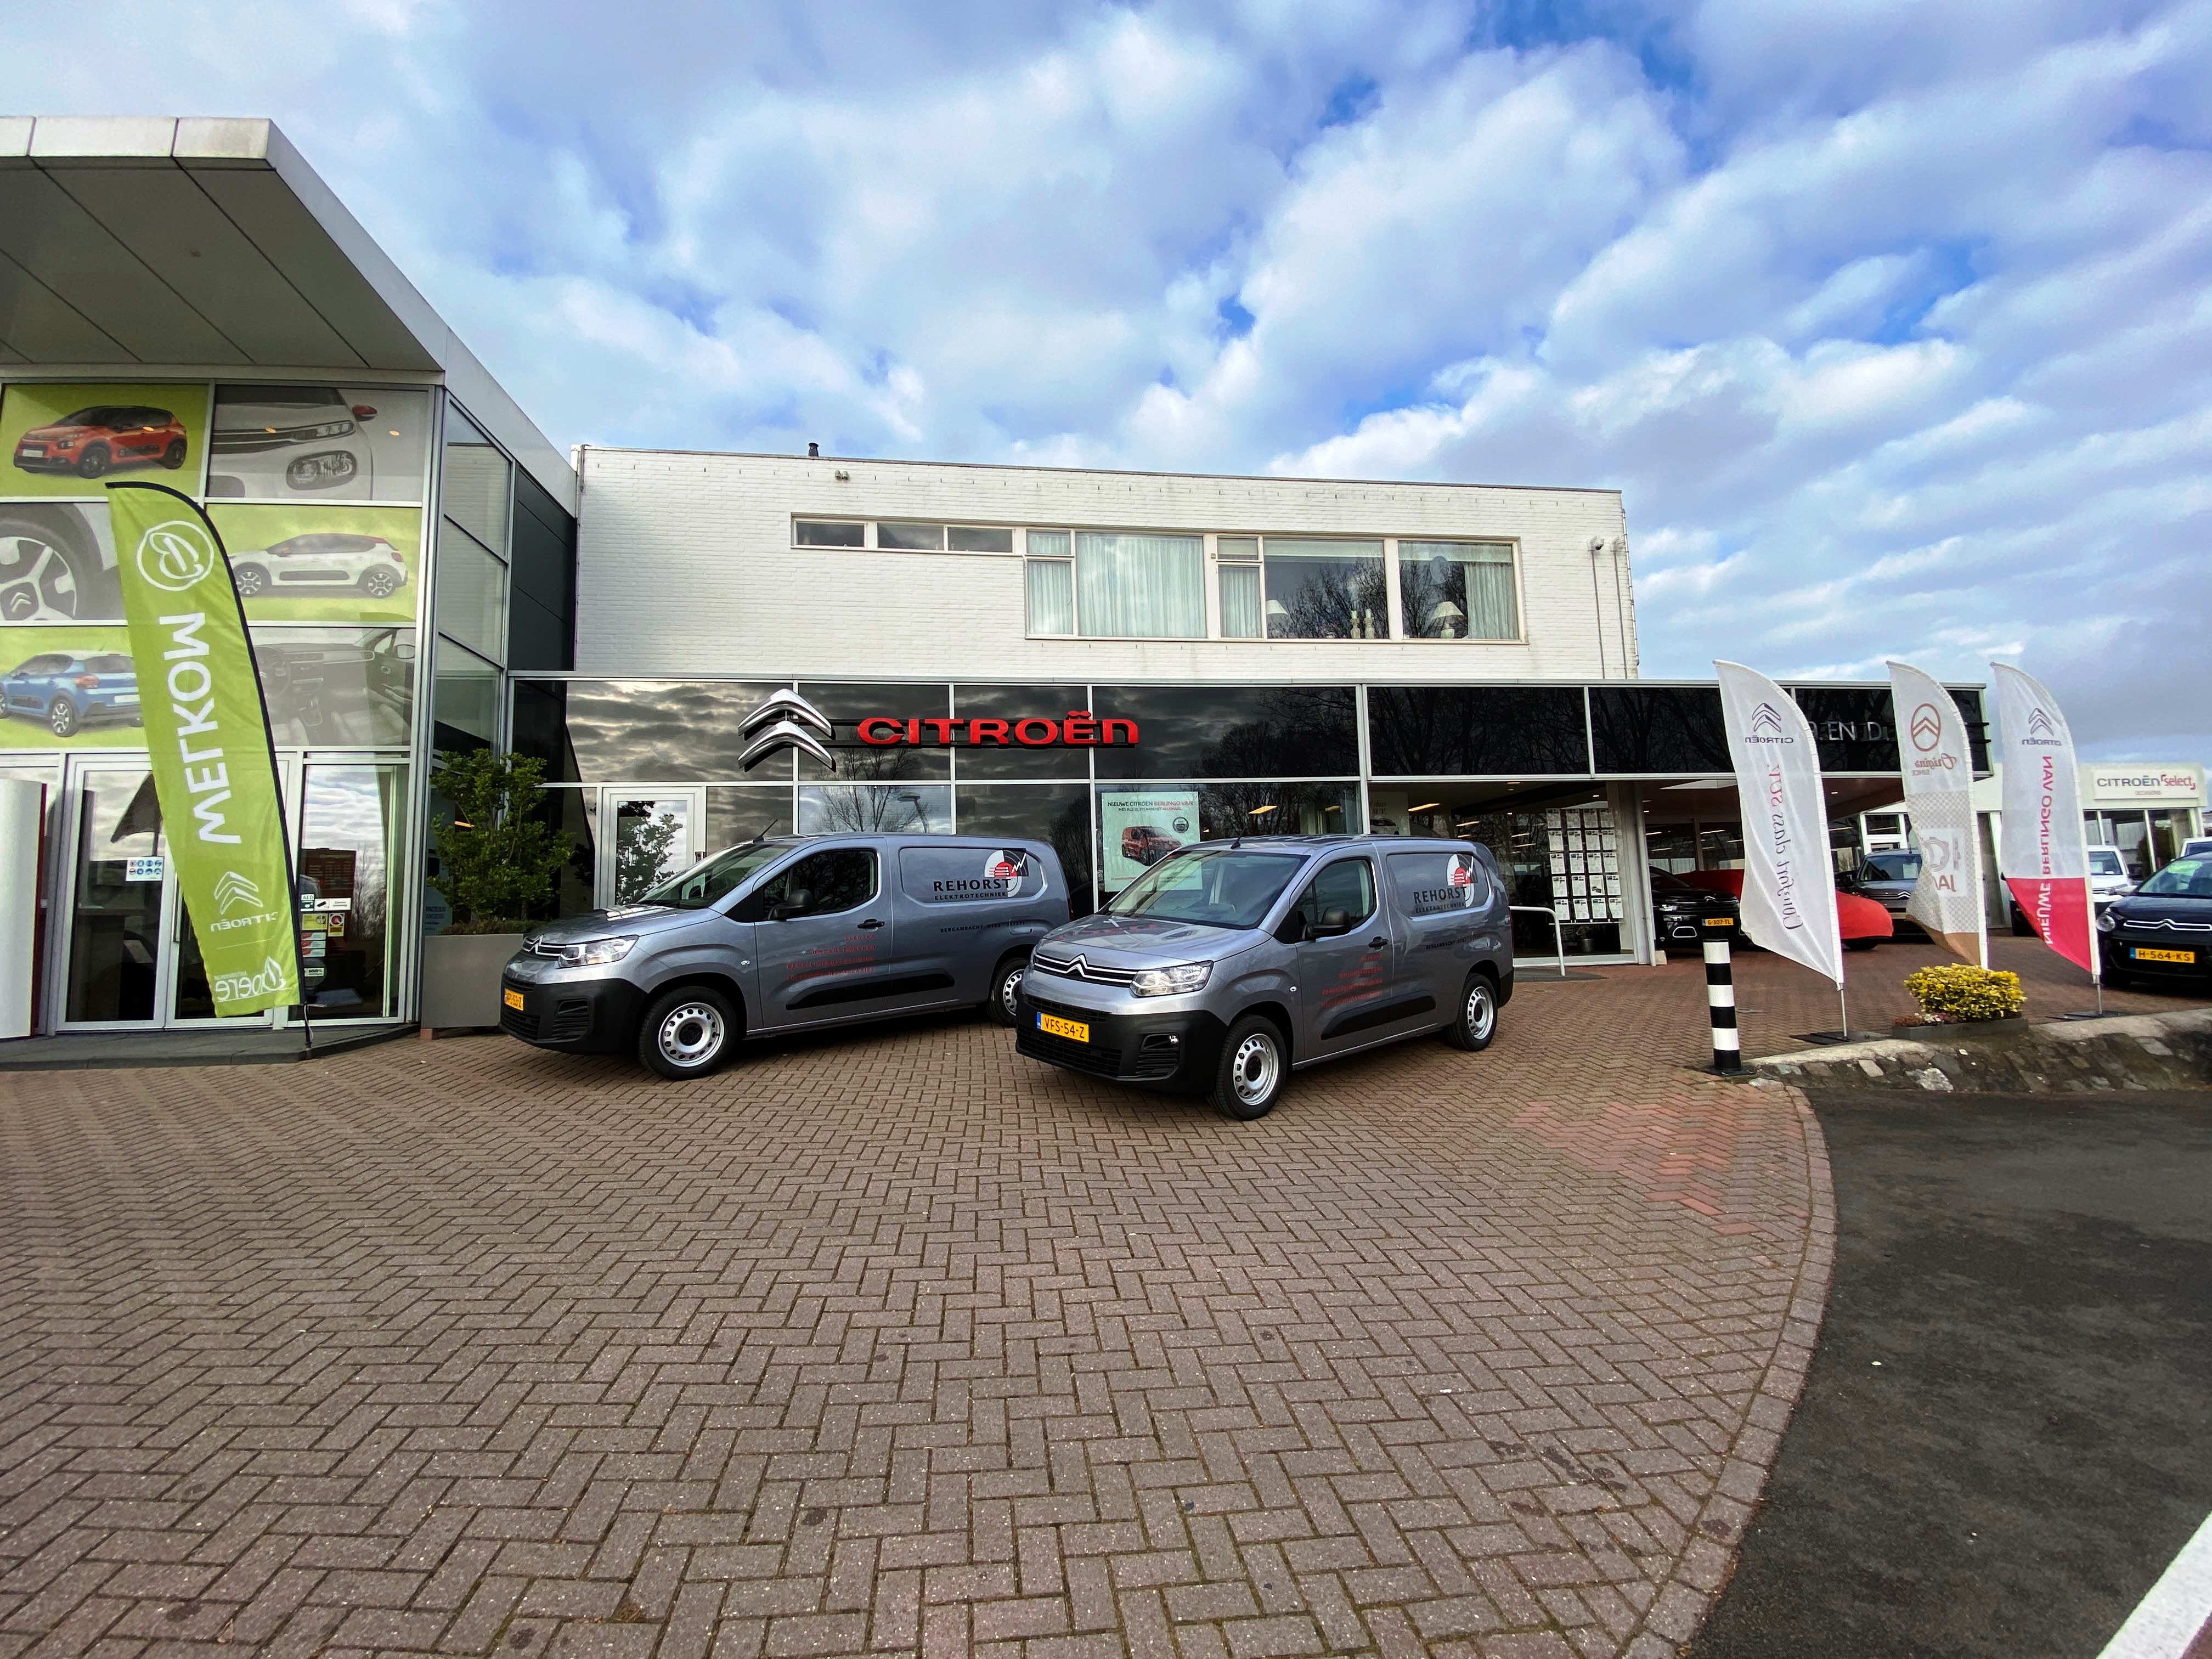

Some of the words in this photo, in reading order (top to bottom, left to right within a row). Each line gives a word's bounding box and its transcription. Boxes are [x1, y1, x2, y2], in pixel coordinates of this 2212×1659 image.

[857, 711, 1139, 746] CITROËN
[1827, 721, 1856, 741] EN
[2097, 775, 2160, 787] CITROËN
[2164, 775, 2193, 786] select
[933, 878, 1012, 892] REHORST
[934, 891, 1008, 900] ELEKTROTECHNIEK
[1413, 886, 1467, 904] REHORST
[940, 924, 984, 933] BERGAMBACHT
[2138, 950, 2191, 961] H-564-KS
[1044, 1017, 1085, 1039] VFS-54-Z
